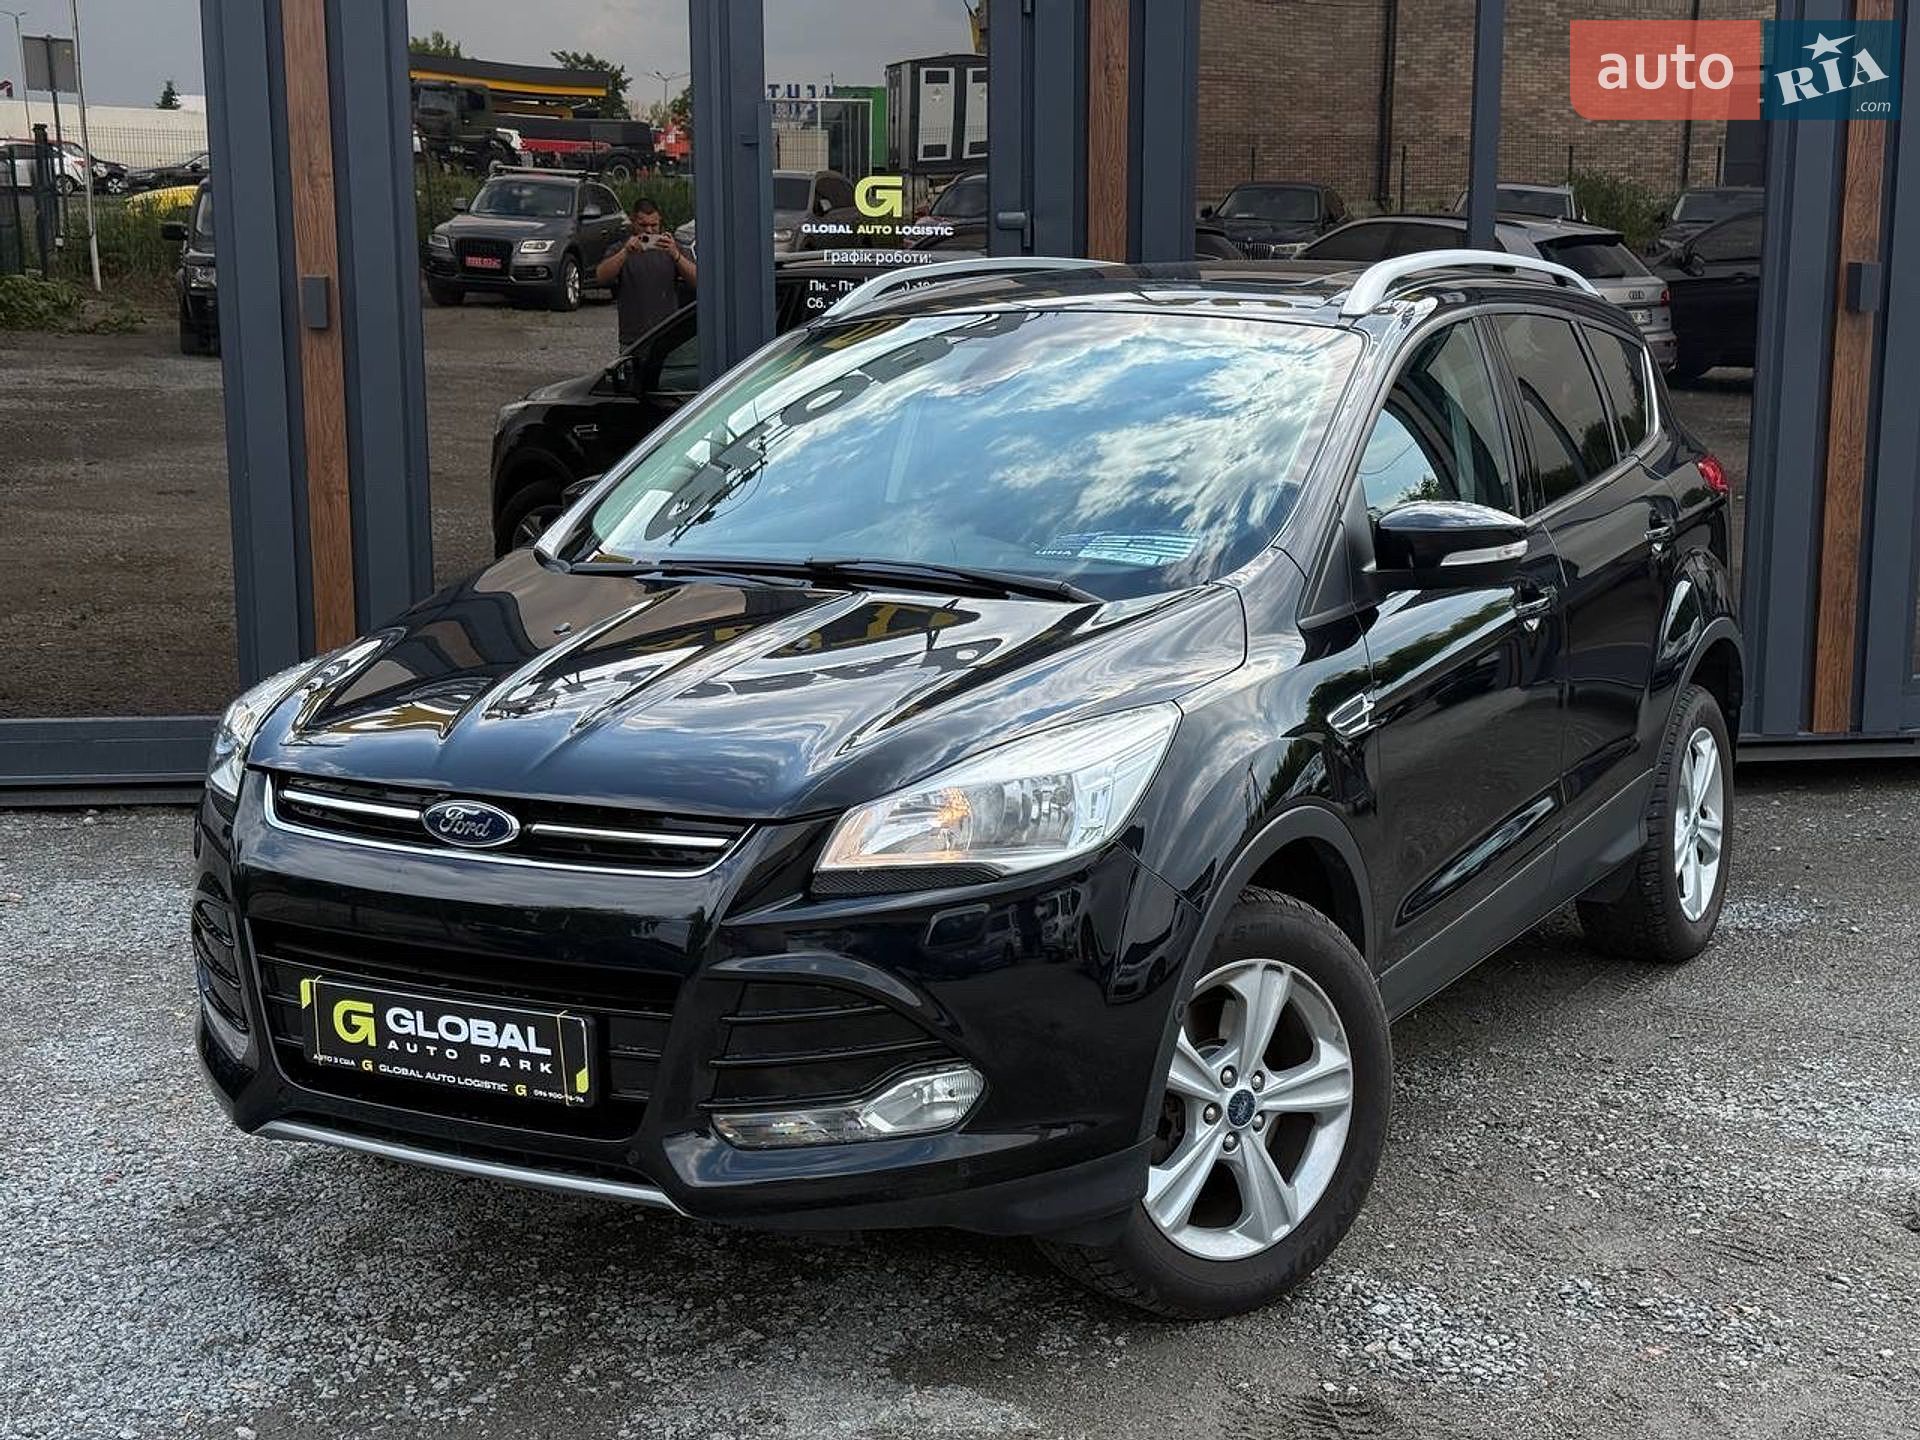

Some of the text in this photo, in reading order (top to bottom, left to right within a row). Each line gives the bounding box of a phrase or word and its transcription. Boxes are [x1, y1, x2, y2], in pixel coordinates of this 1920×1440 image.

[801, 223, 954, 236] GLOBAL AUTO LOGISTIC
[823, 249, 932, 265] Графік роботи:
[807, 297, 826, 309] Сб.
[440, 806, 492, 837] Ford
[385, 1007, 552, 1056] GLOBAL
[387, 1039, 552, 1075] AUTO PARK
[379, 1063, 423, 1079] GLOBAL
[425, 1071, 456, 1084] AUTO
[457, 1076, 509, 1092] LOGISTIC
